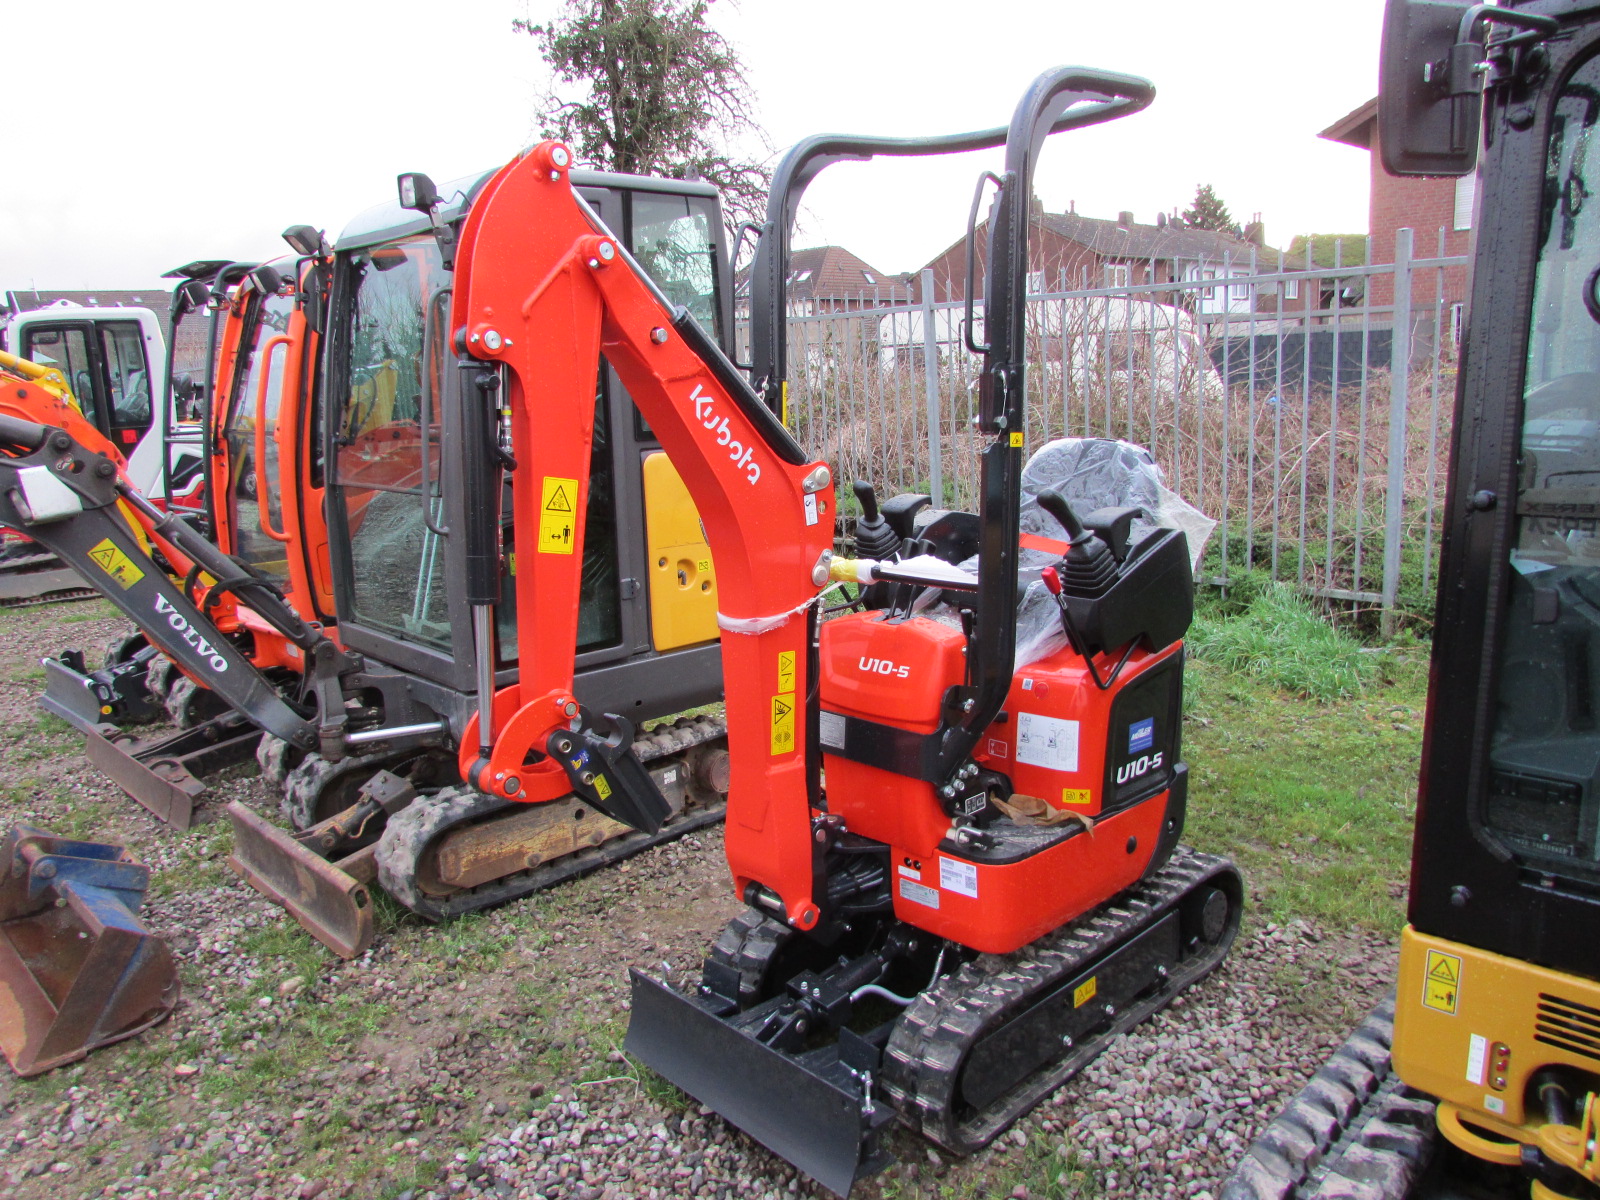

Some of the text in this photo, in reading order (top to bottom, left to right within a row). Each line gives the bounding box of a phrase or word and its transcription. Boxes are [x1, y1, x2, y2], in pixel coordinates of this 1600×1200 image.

[689, 383, 761, 485] Kubota
[155, 592, 228, 672] VOLVO
[858, 656, 911, 678] U10-5
[1116, 751, 1163, 784] U10-5
